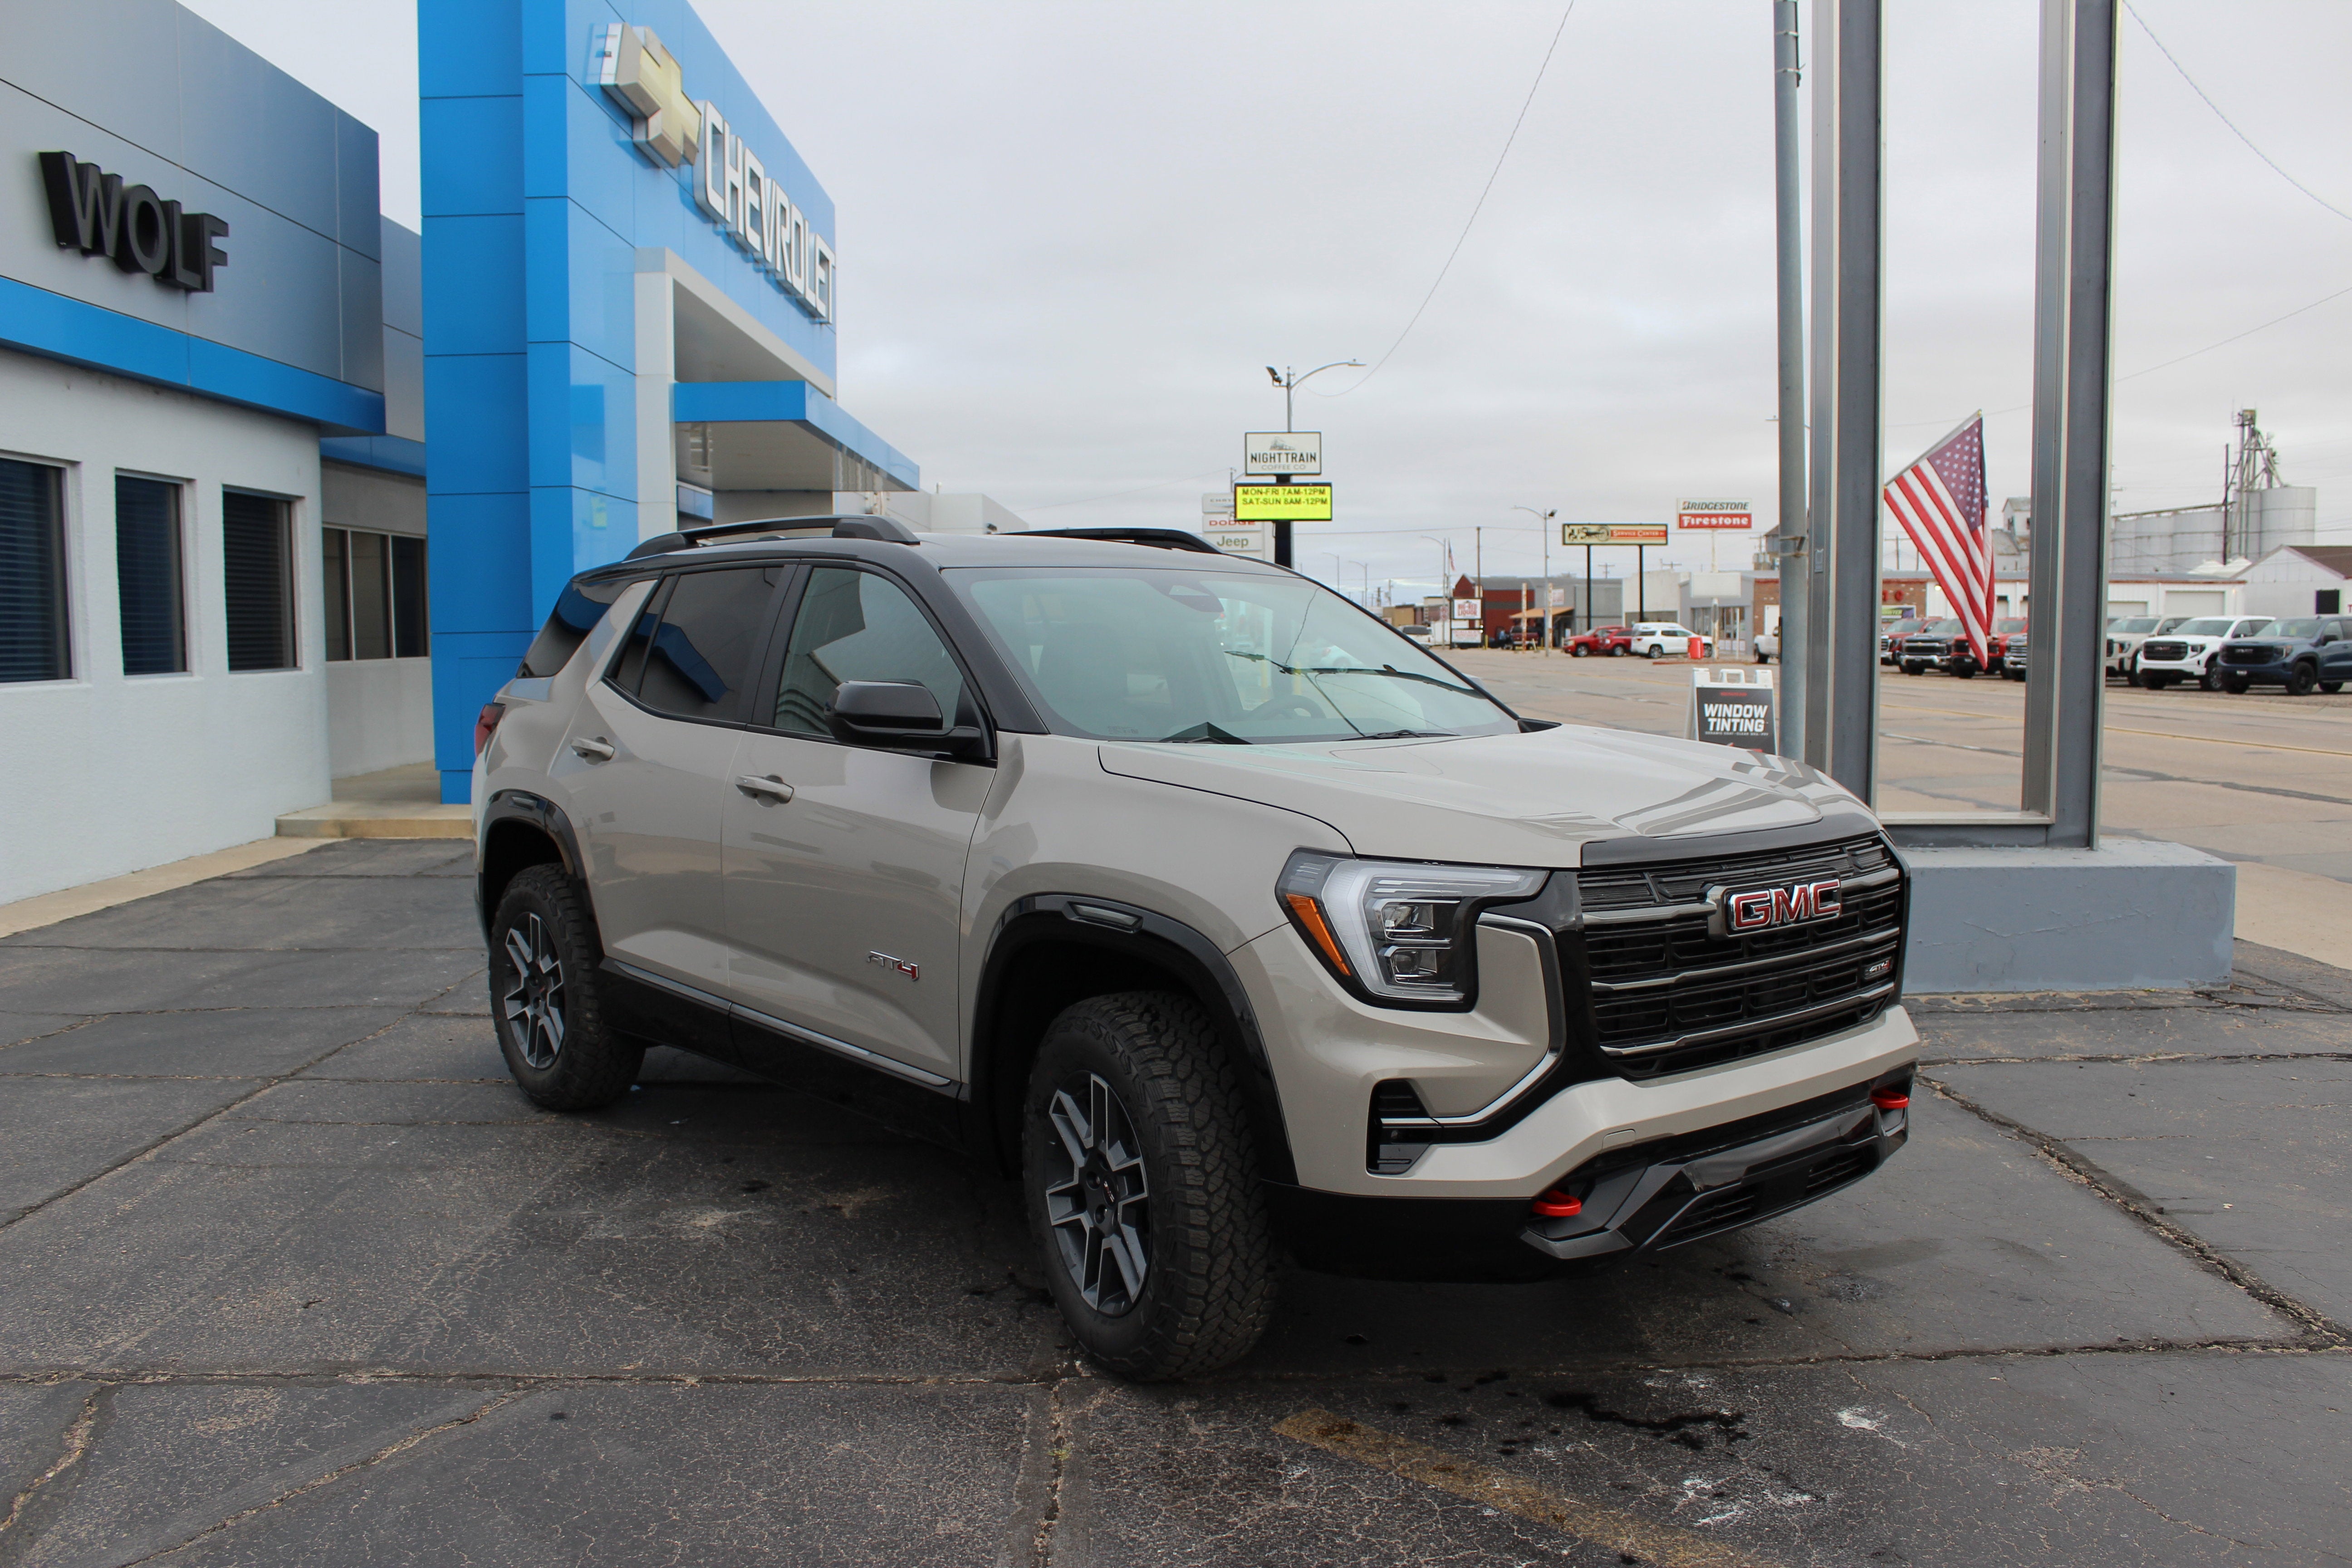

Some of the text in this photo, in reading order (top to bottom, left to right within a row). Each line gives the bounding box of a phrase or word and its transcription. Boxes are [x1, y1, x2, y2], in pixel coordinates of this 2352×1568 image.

[693, 100, 836, 325] CHEVROLET
[39, 151, 229, 293] WOLF
[1682, 501, 1749, 510] BRIDGESTONE
[1682, 515, 1749, 527] Firestone
[1217, 535, 1249, 548] Jeep
[1704, 703, 1769, 718] WINDOW
[1707, 718, 1765, 732] TINTING
[1729, 879, 1841, 931] GMC
[867, 950, 919, 981] AT4
